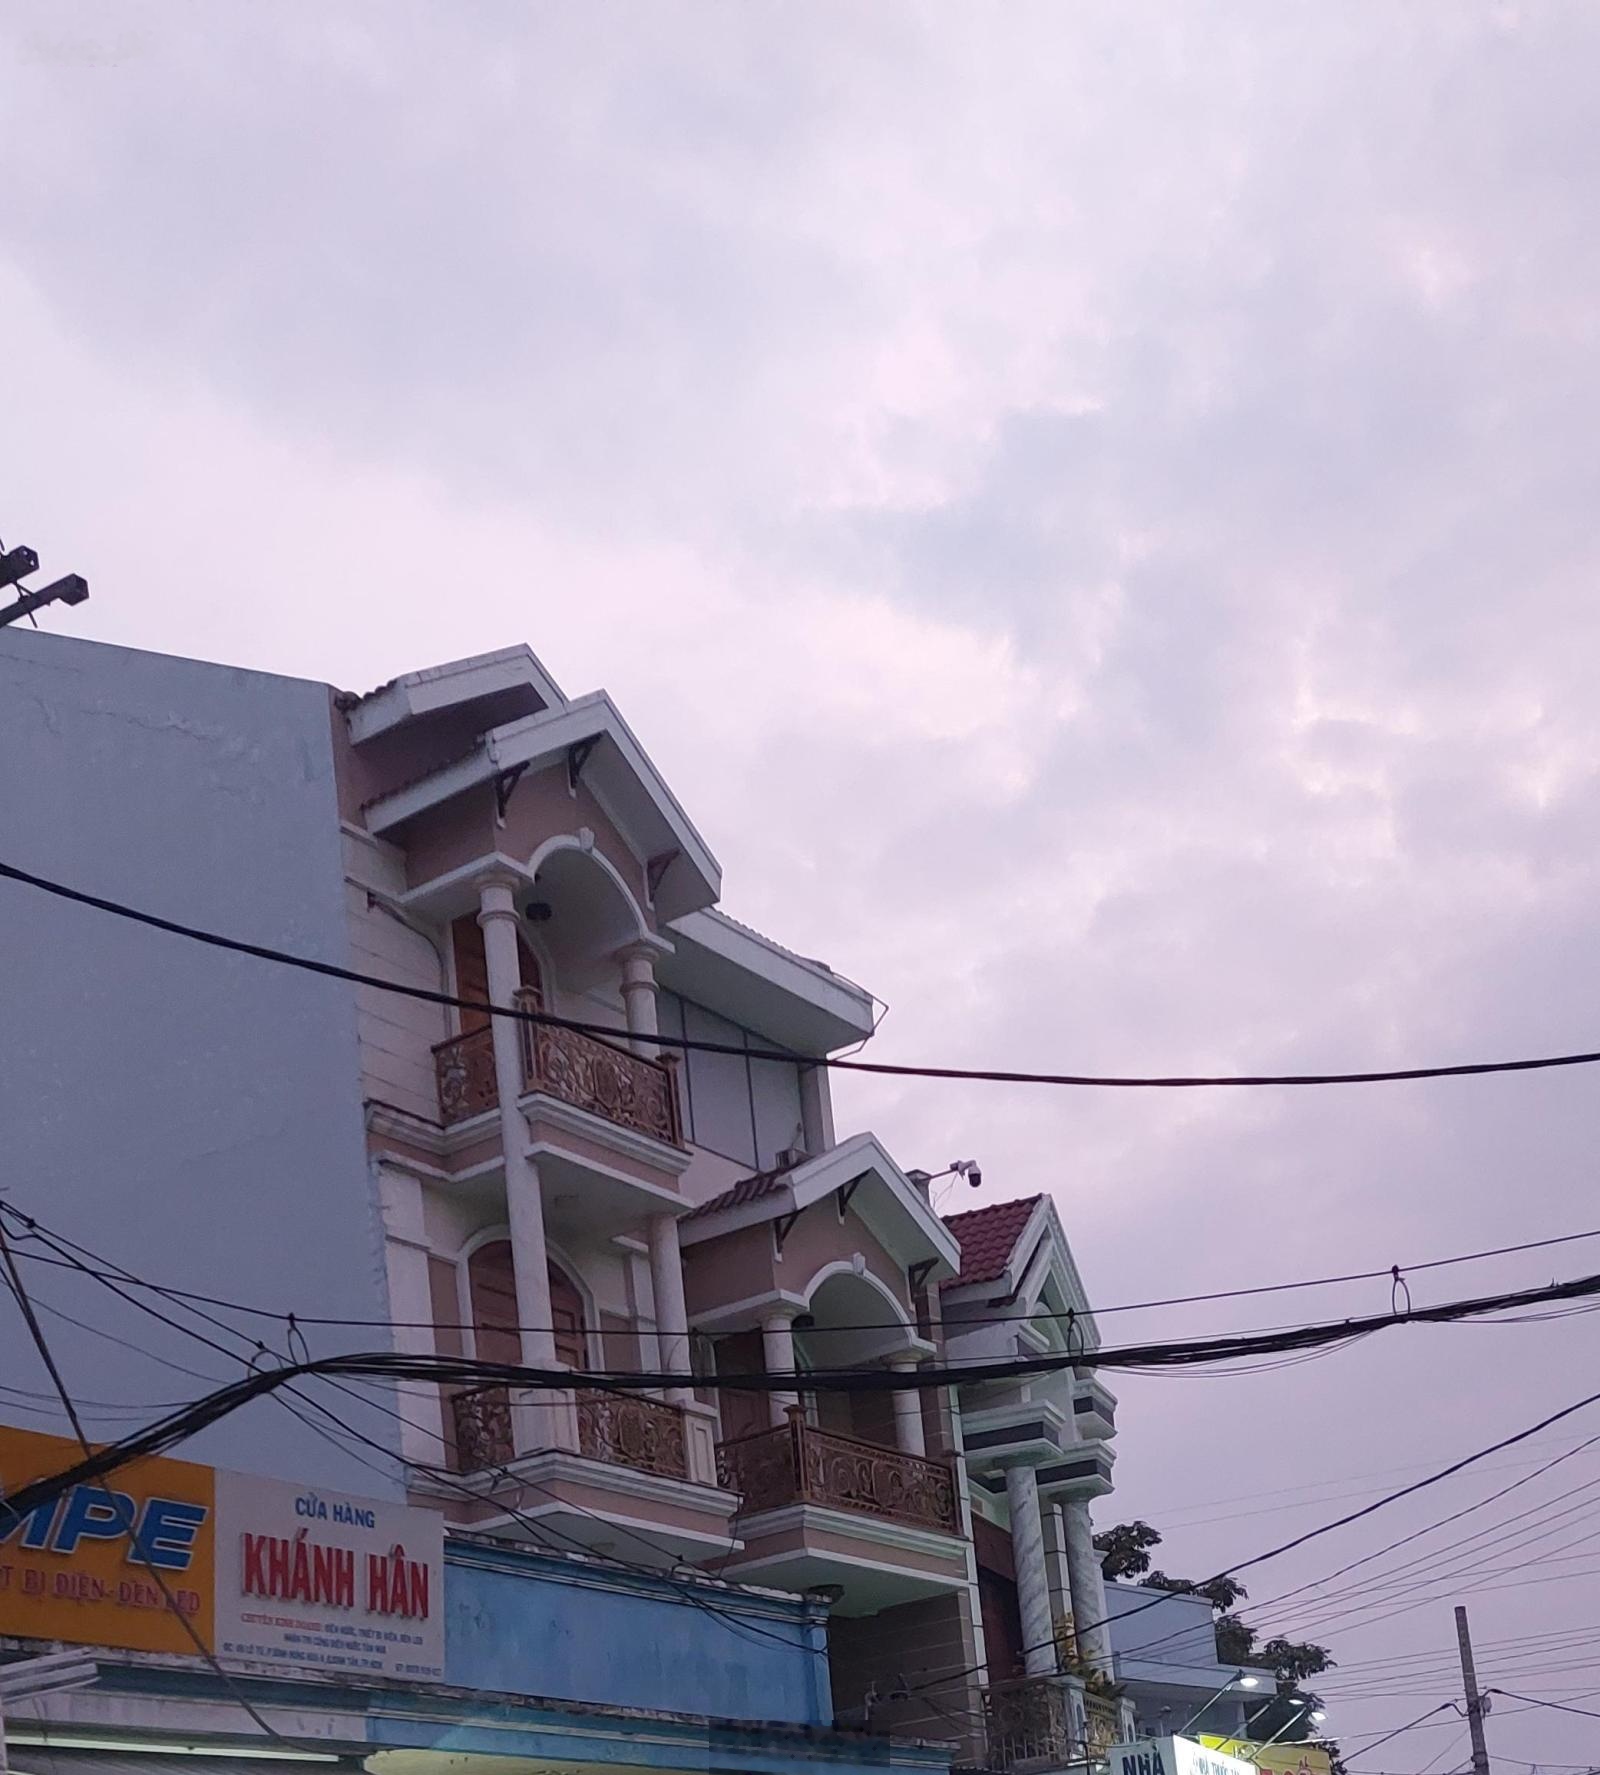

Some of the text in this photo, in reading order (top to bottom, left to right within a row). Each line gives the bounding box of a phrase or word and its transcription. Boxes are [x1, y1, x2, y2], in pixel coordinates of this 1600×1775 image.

[294, 1493, 376, 1528] CỬA HÀNG
[242, 1527, 429, 1618] KHÁNH HÂN
